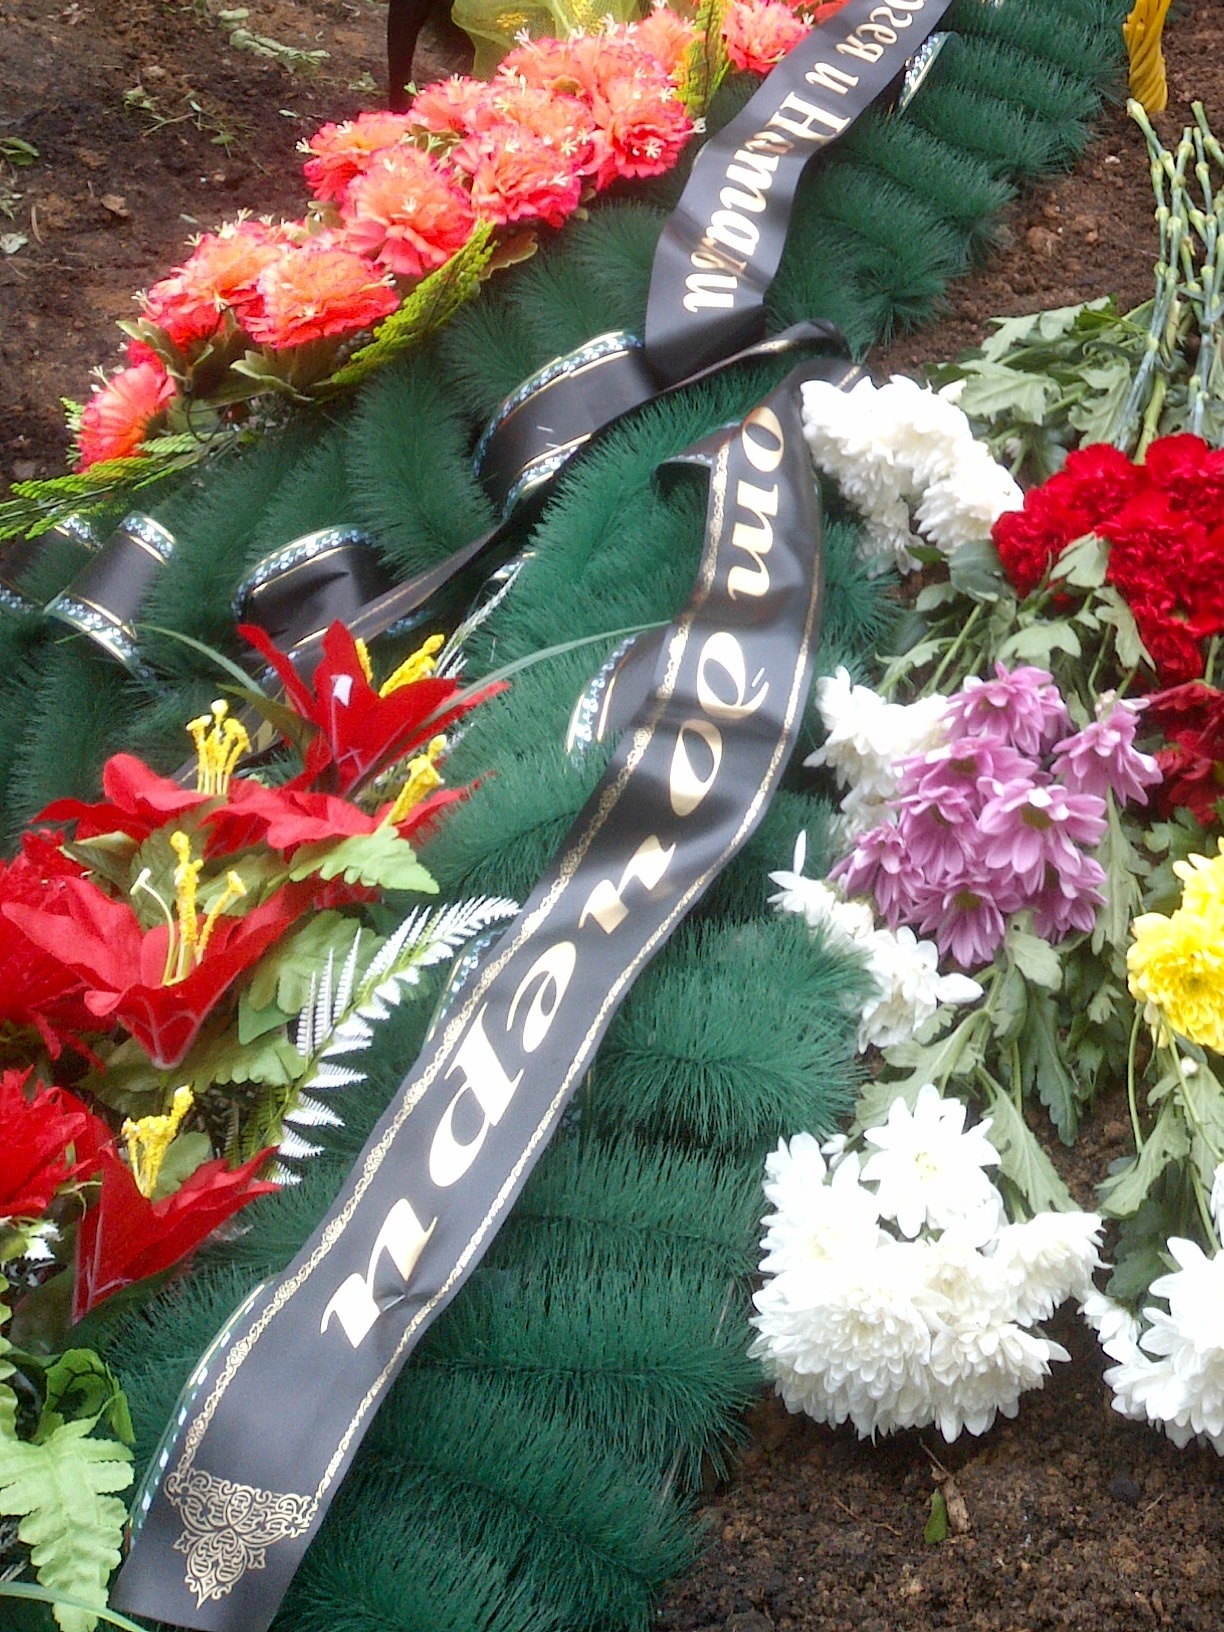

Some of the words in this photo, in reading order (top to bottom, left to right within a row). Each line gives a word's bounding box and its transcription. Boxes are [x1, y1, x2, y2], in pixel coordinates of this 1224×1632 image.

[804, 61, 861, 96] и
[727, 404, 786, 604] от
[320, 630, 772, 1352] дочери
